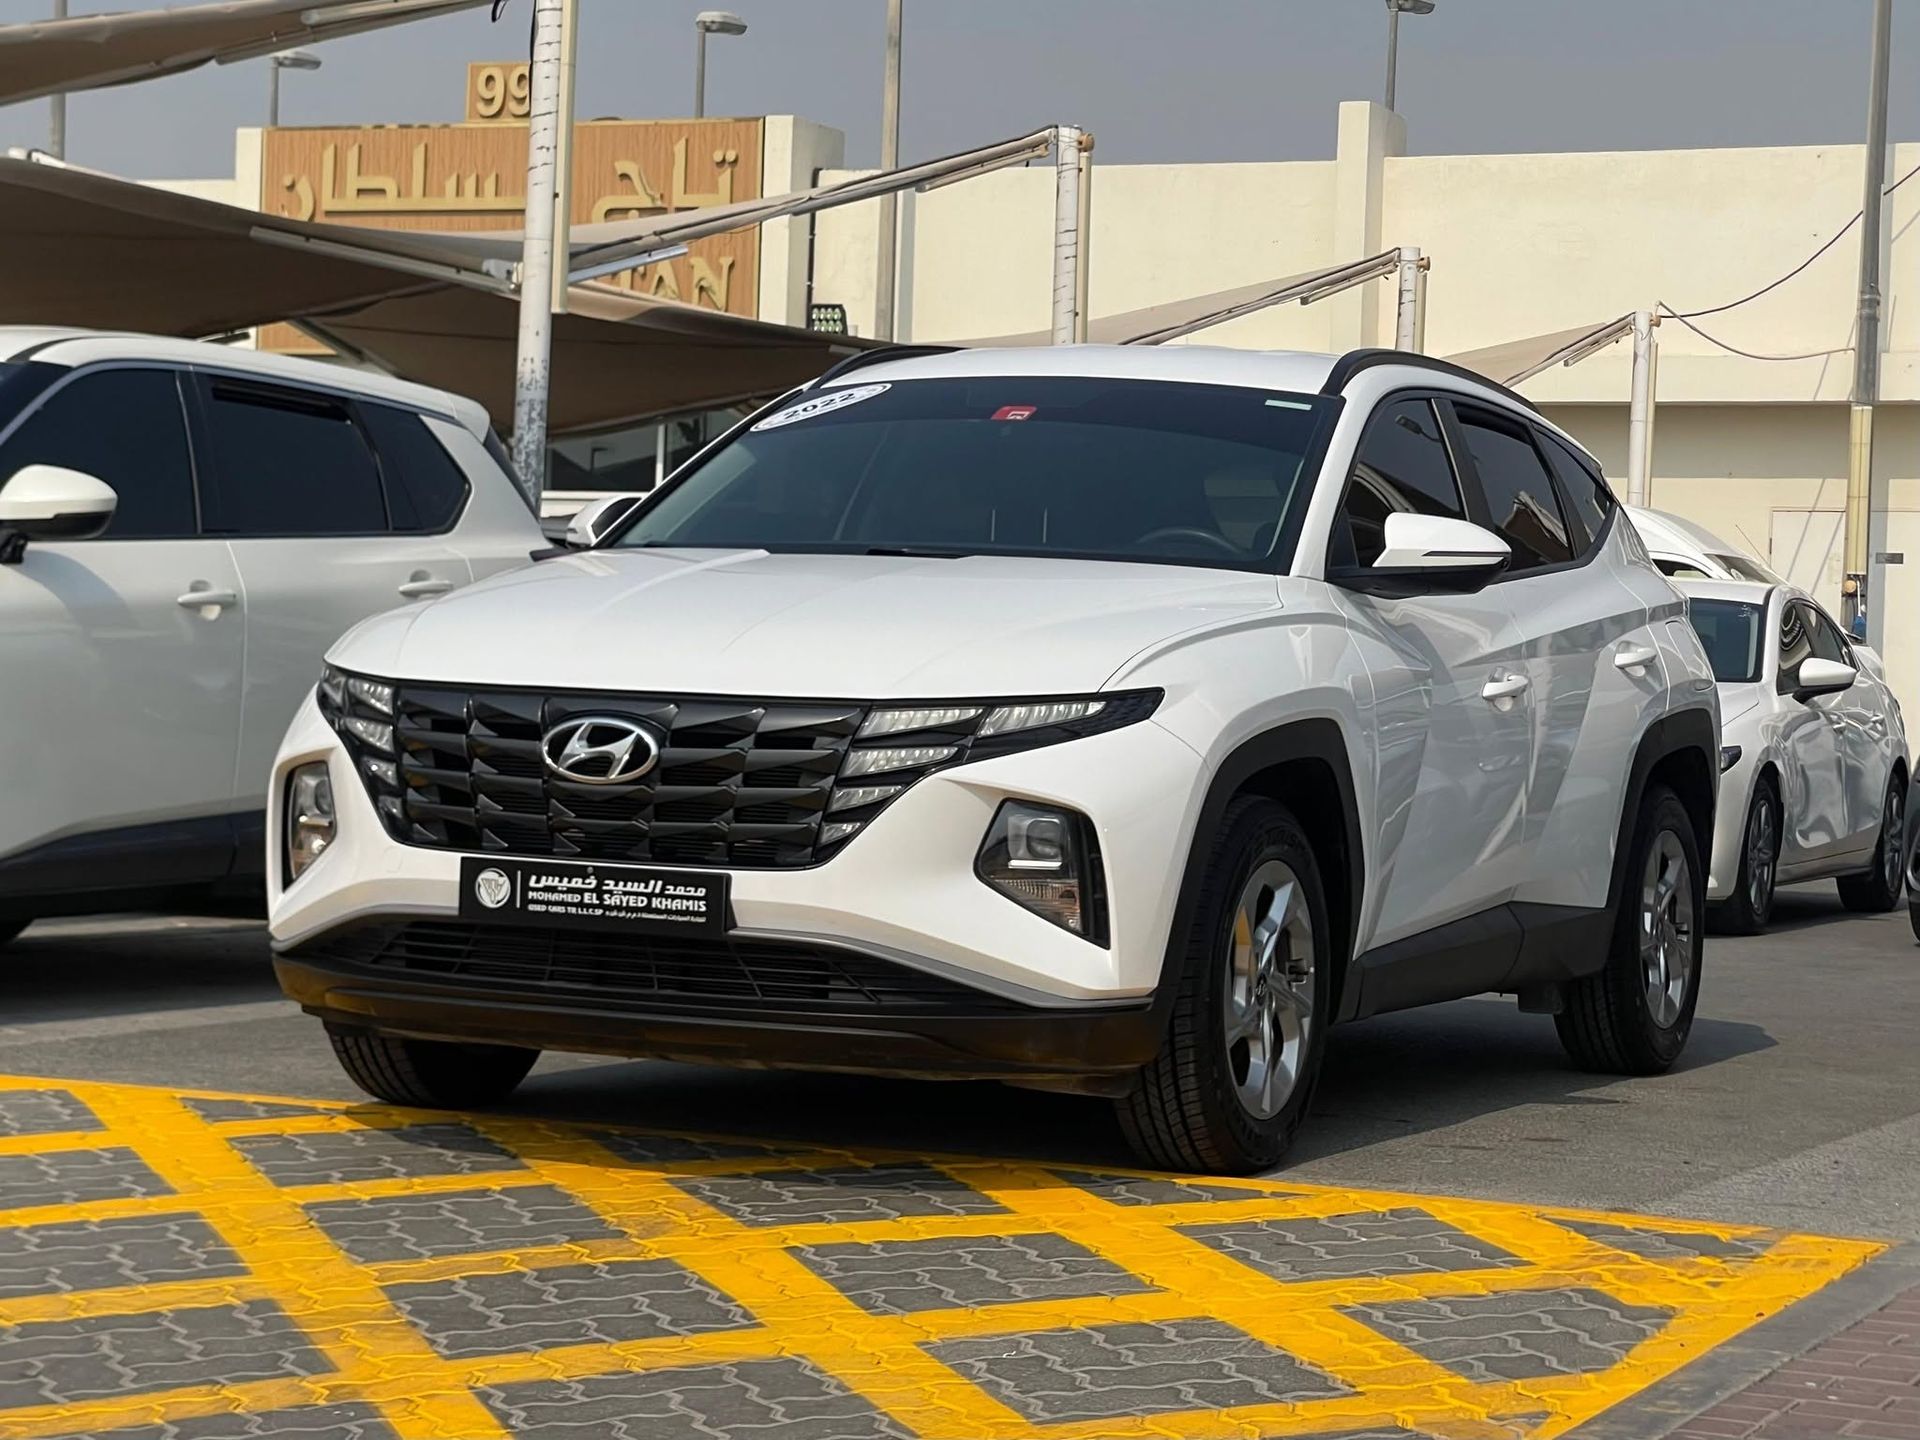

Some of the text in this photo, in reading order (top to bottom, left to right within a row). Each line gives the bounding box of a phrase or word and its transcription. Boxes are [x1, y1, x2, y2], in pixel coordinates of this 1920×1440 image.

[784, 392, 857, 420] 2022
[530, 875, 707, 897] محمد السيد خميس
[528, 891, 707, 912] MOHAMED EL SAYED KHAMIS
